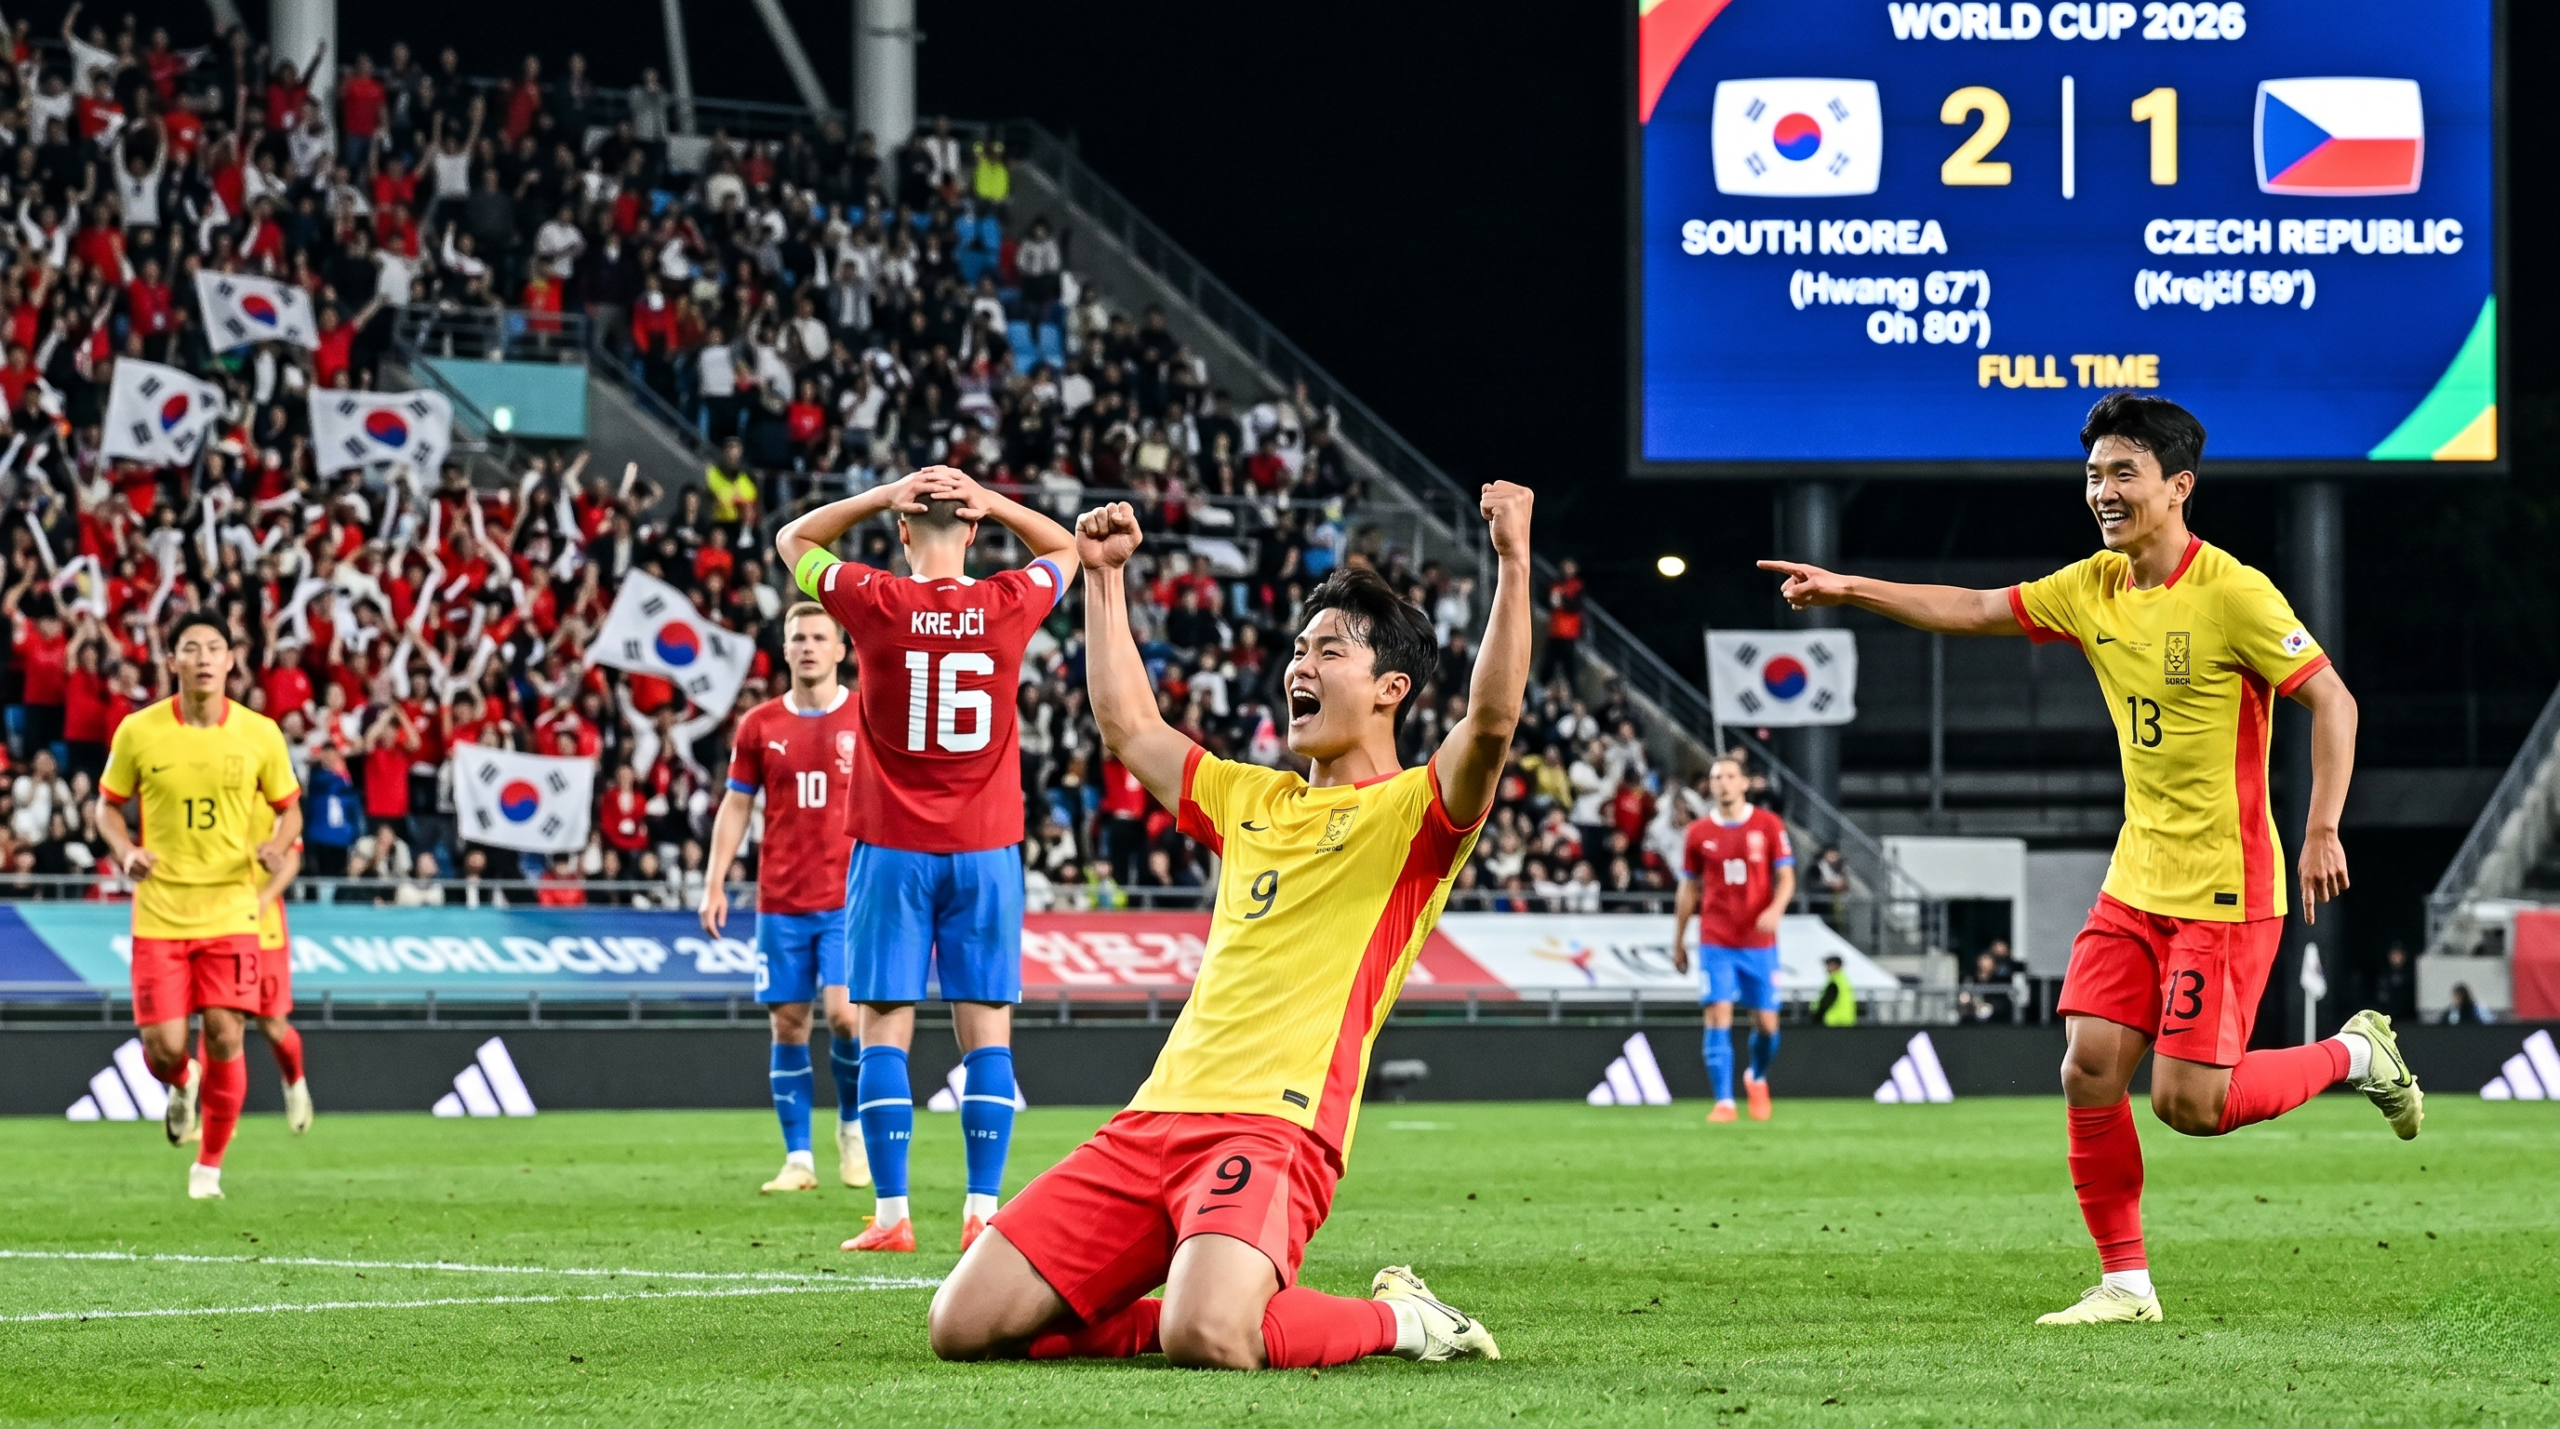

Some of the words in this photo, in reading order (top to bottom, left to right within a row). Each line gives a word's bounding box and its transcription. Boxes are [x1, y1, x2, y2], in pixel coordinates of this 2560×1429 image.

[1888, 2, 2043, 41] WORLD
[2049, 2, 2137, 41] CUP
[2142, 2, 2247, 41] 2026
[1940, 86, 2012, 186] 2
[2131, 87, 2178, 186] 1
[1682, 219, 1812, 255] SOUTH
[1818, 219, 1948, 255] KOREA
[2144, 219, 2273, 255] CZECH
[2278, 219, 2464, 255] REPUBLIC
[1790, 269, 1920, 312] (Hwang
[1866, 310, 1919, 345] Oh
[1978, 354, 2068, 389] FULL
[2070, 354, 2161, 389] TIME
[911, 608, 985, 639] KREJČÍ
[905, 651, 995, 752] 16
[2126, 696, 2163, 748] 13
[795, 771, 828, 809] 10
[183, 797, 217, 830] 13
[1243, 869, 1279, 920] 9
[331, 936, 668, 974] WORLDCUP
[2165, 969, 2206, 1020] 13
[1209, 1155, 1252, 1196] 9
